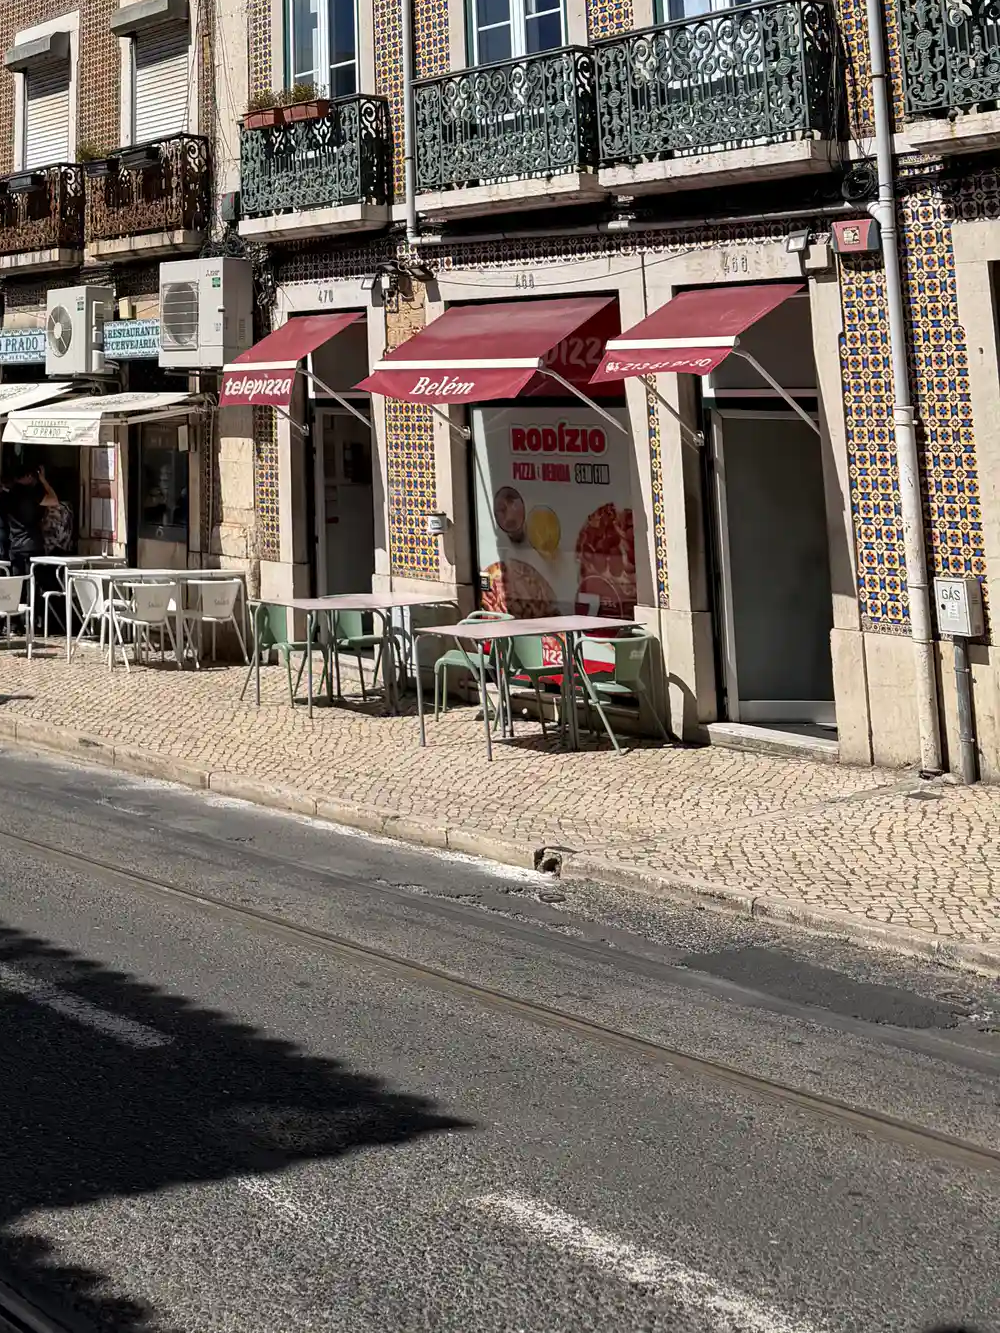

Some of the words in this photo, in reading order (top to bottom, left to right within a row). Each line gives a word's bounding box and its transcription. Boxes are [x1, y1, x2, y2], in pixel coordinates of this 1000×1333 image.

[318, 289, 334, 303] 470
[107, 326, 160, 339] RESTAURANTE
[5, 337, 39, 352] PRADO
[111, 339, 157, 351] CERVEJARIA
[224, 373, 292, 401] telepizza
[409, 376, 476, 396] Belém
[511, 421, 606, 454] RODÍZIO
[512, 462, 536, 481] PIZZA
[941, 586, 961, 601] GÁS
